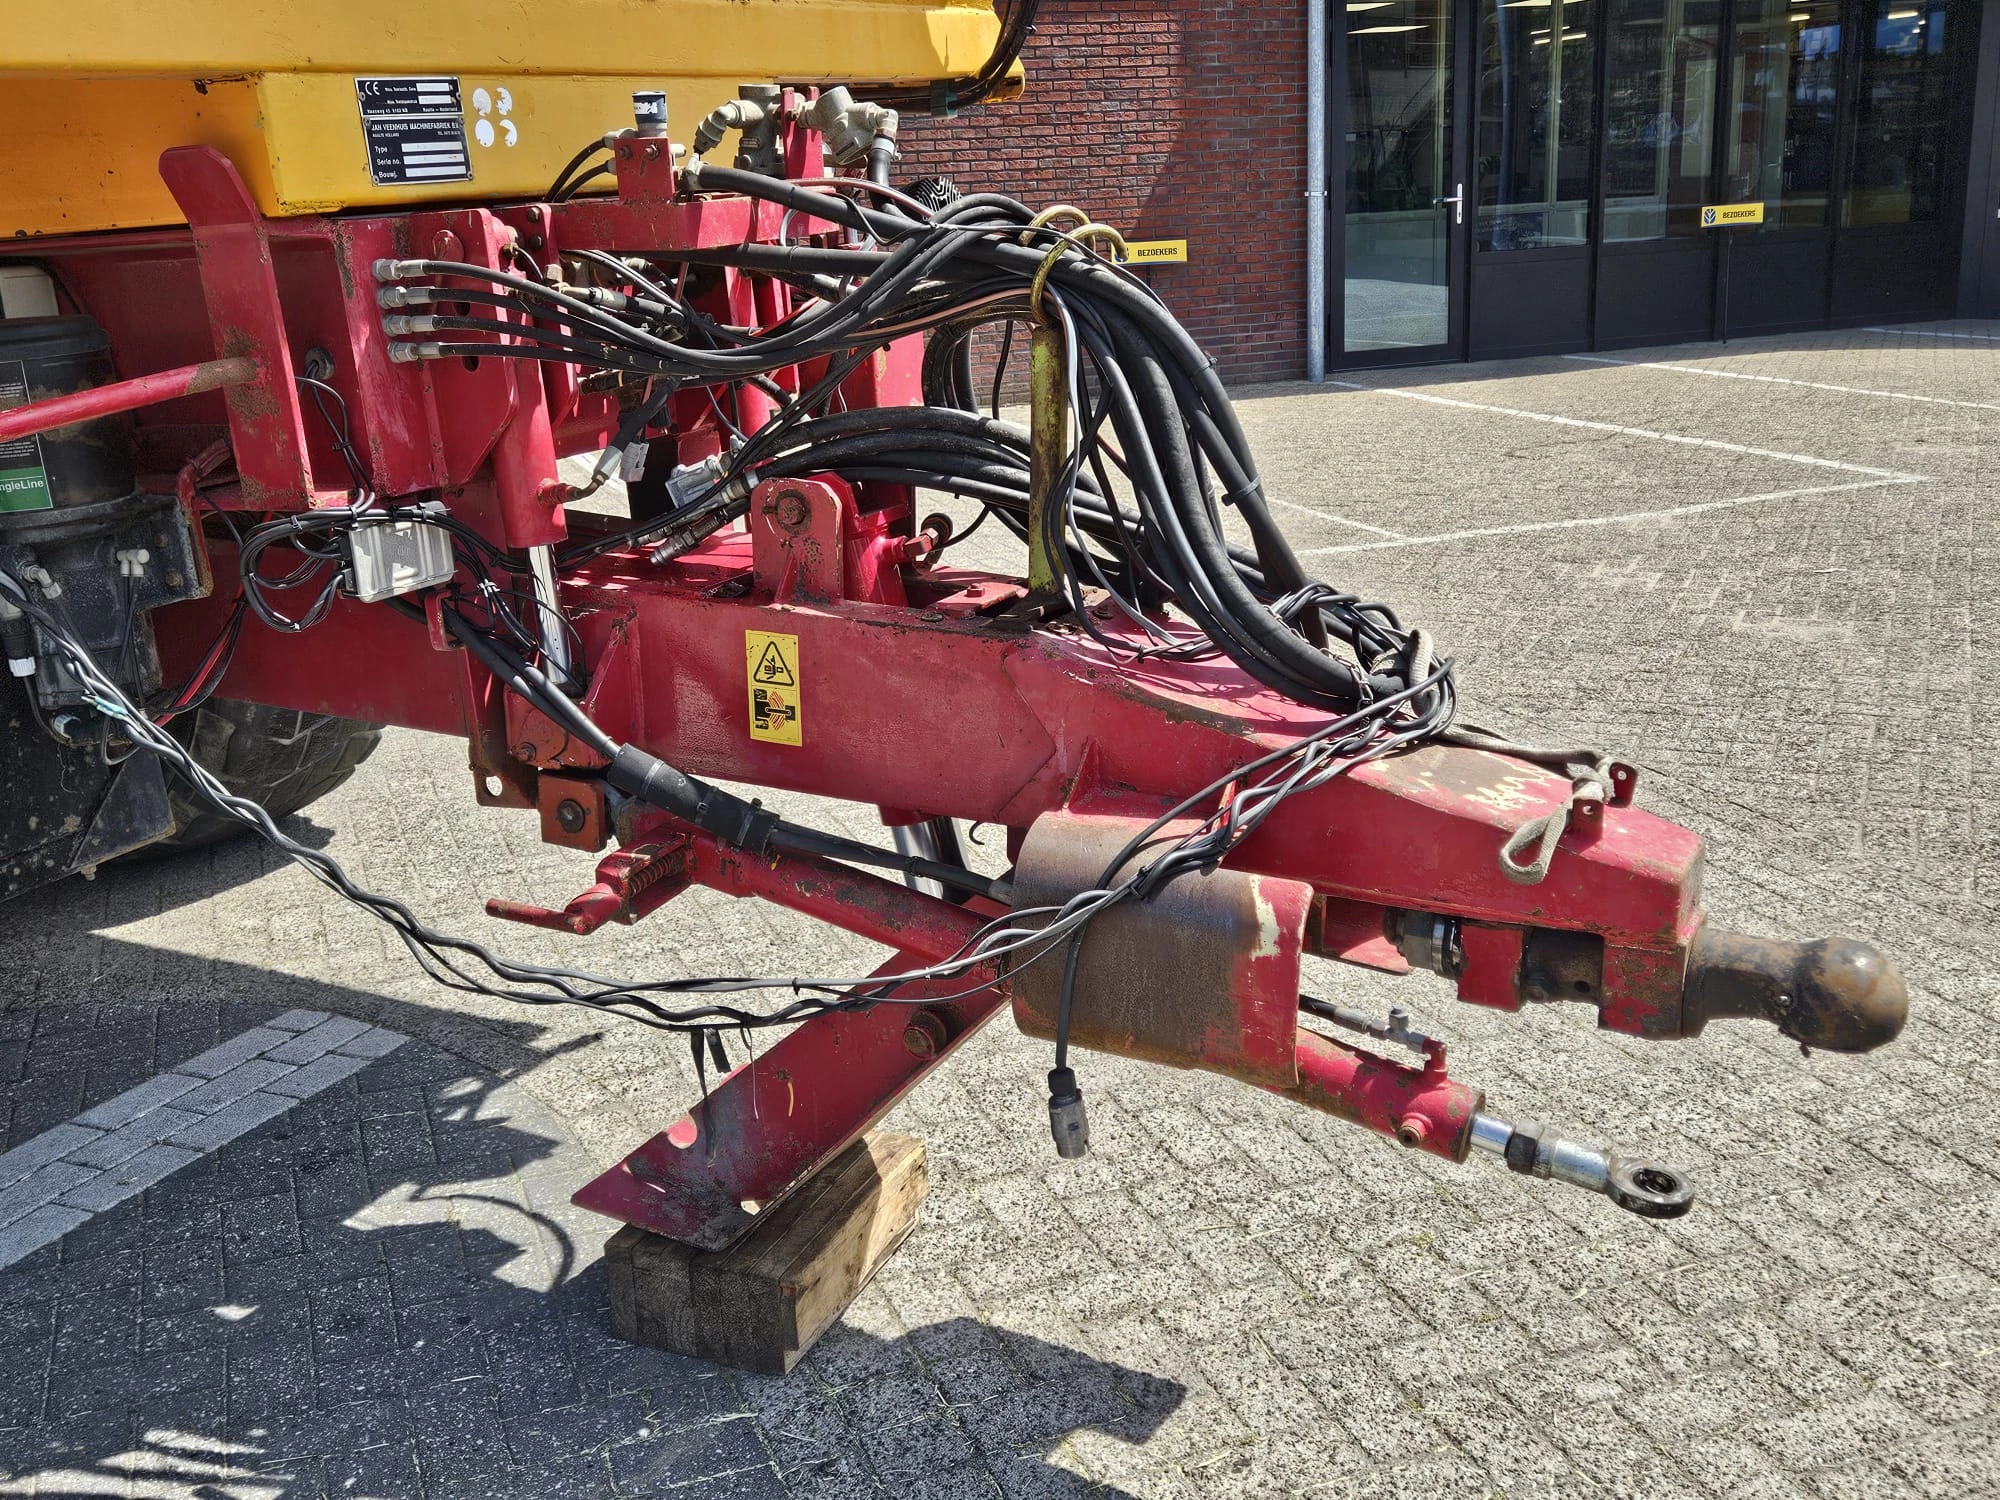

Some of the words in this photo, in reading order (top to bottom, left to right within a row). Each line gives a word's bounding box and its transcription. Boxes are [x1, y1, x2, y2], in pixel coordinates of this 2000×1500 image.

[365, 81, 380, 95] CE
[372, 123, 382, 131] JAN
[382, 123, 408, 131] VEENHUIS
[409, 121, 451, 130] MACHINEFABRIEK
[374, 145, 387, 154] Type
[376, 157, 391, 165] Serie
[1722, 210, 1756, 219] BEZOEKERS
[1138, 248, 1178, 256] BEZOEKERS
